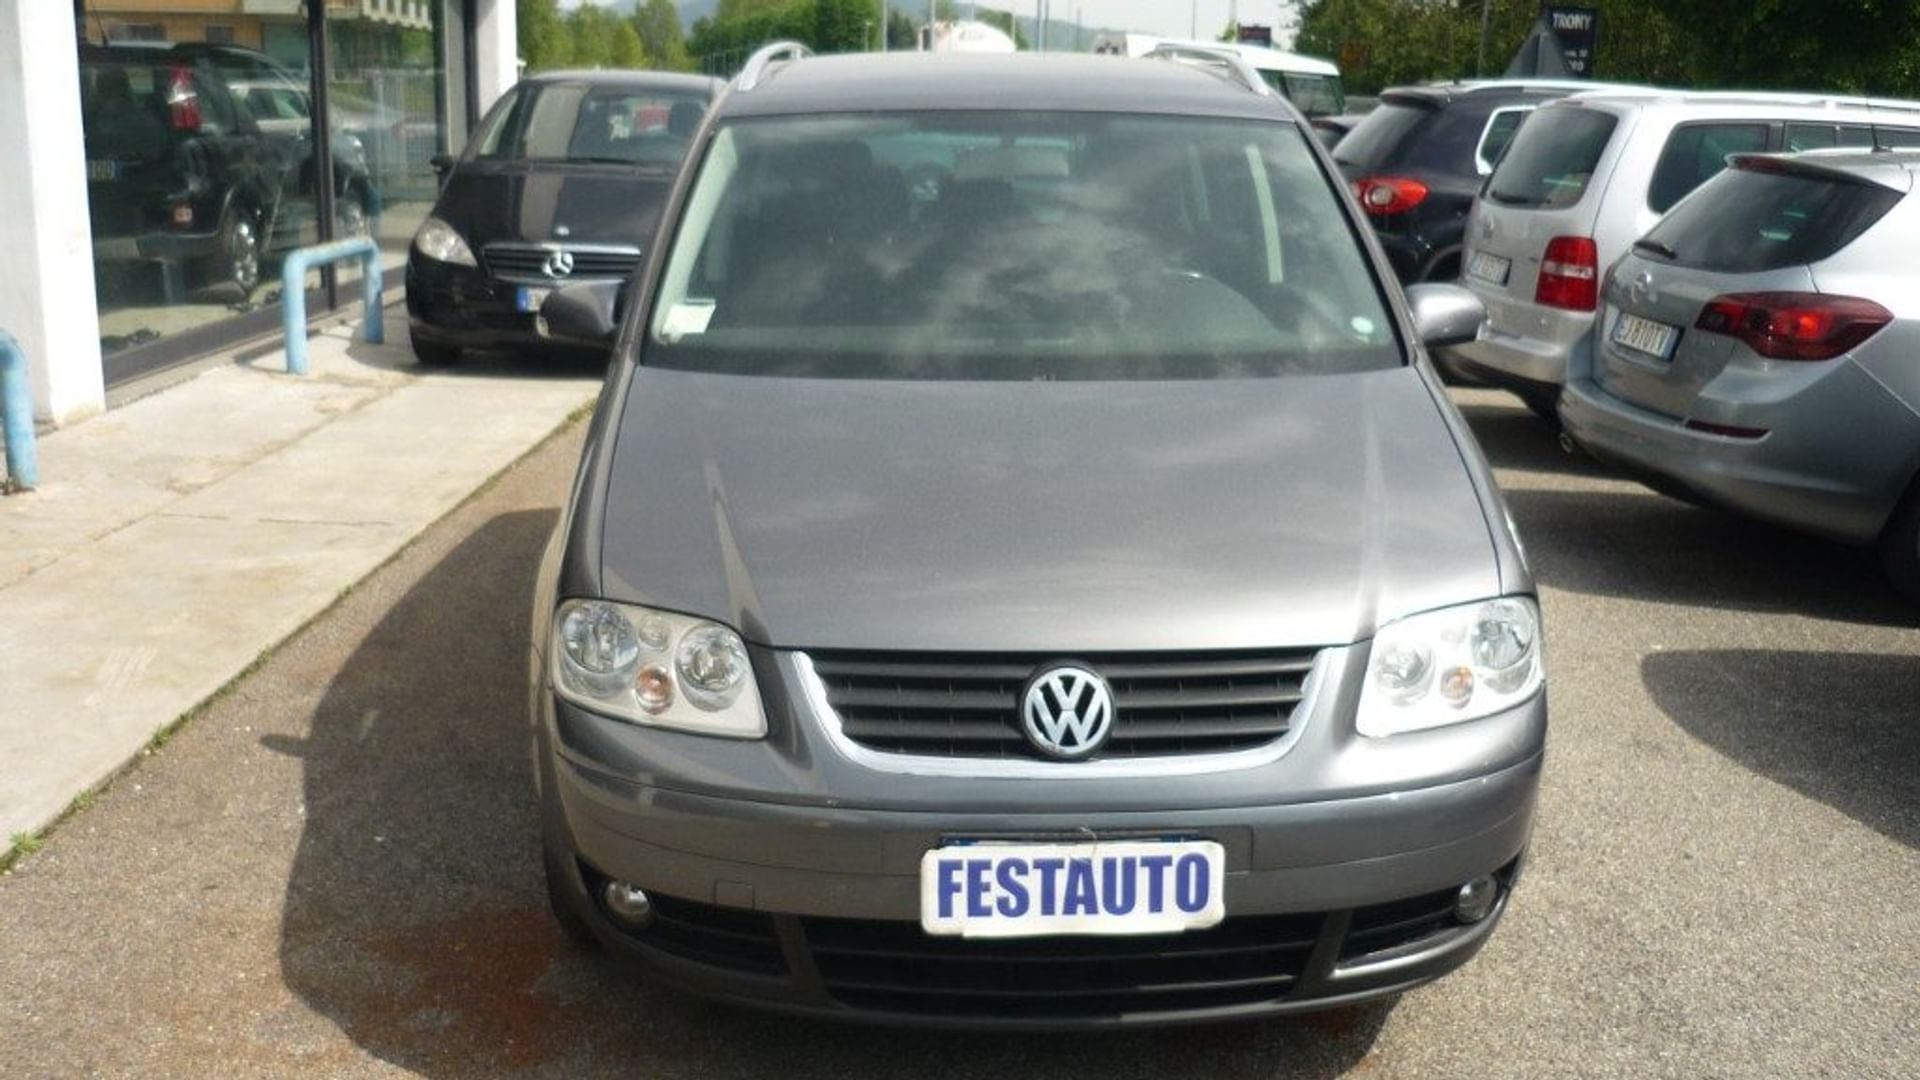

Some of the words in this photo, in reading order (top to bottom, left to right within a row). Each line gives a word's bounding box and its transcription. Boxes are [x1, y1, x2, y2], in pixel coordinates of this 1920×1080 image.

[1552, 12, 1592, 31] TRONY
[1025, 667, 1111, 753] VW
[937, 852, 1211, 919] FESTAUTO
